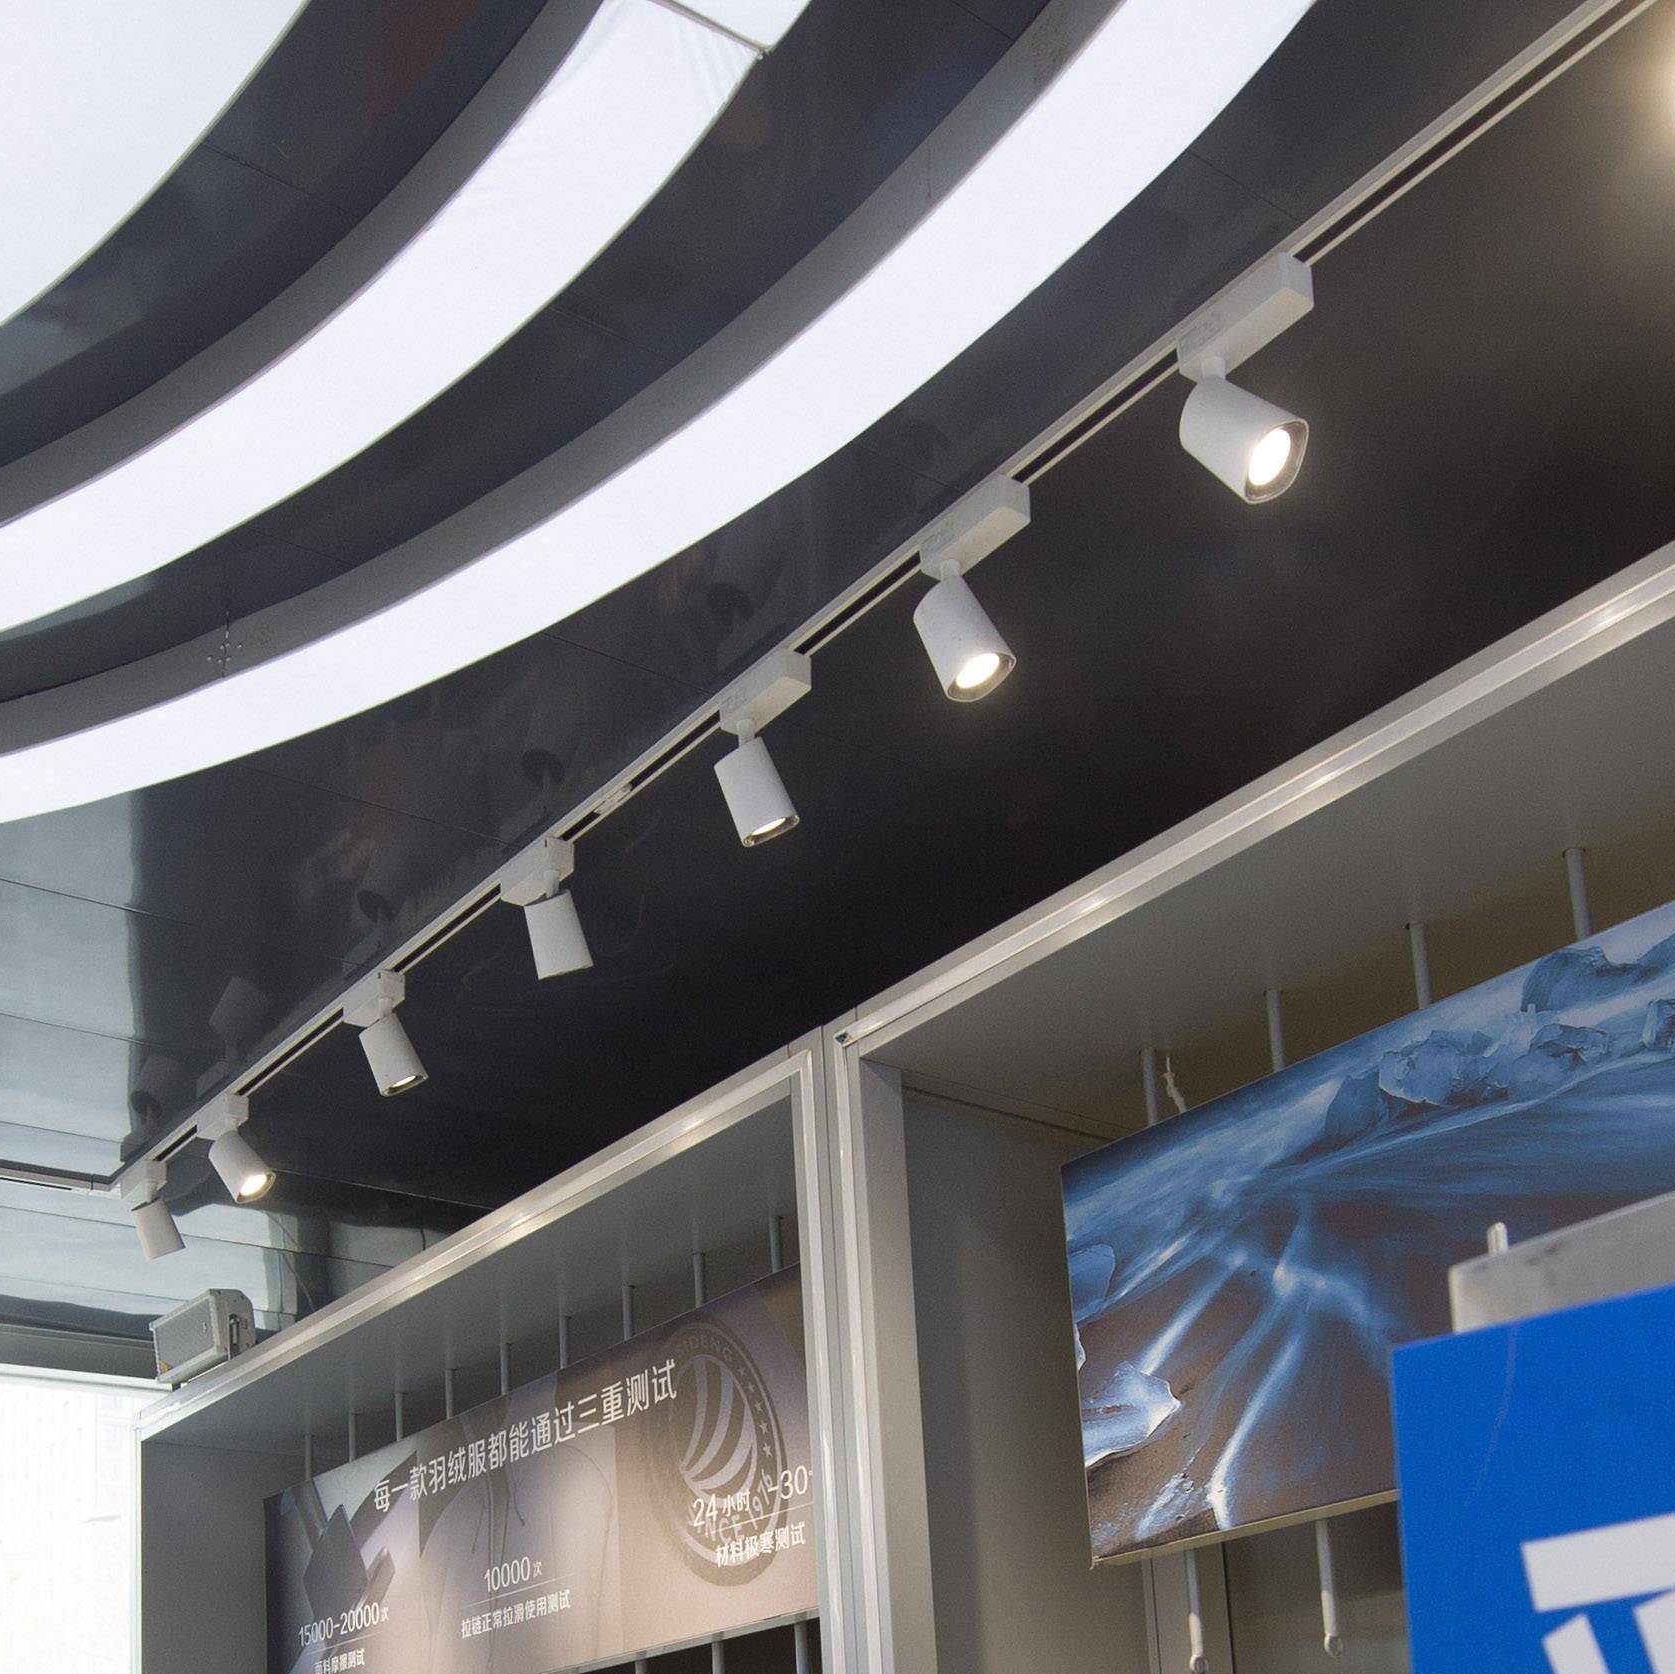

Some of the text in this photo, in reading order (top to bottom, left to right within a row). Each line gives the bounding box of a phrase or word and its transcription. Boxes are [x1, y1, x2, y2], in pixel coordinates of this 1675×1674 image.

[373, 1358, 678, 1514] 每一款羽绒服都能通过三重测试
[715, 1521, 806, 1568] 材料极寒测试
